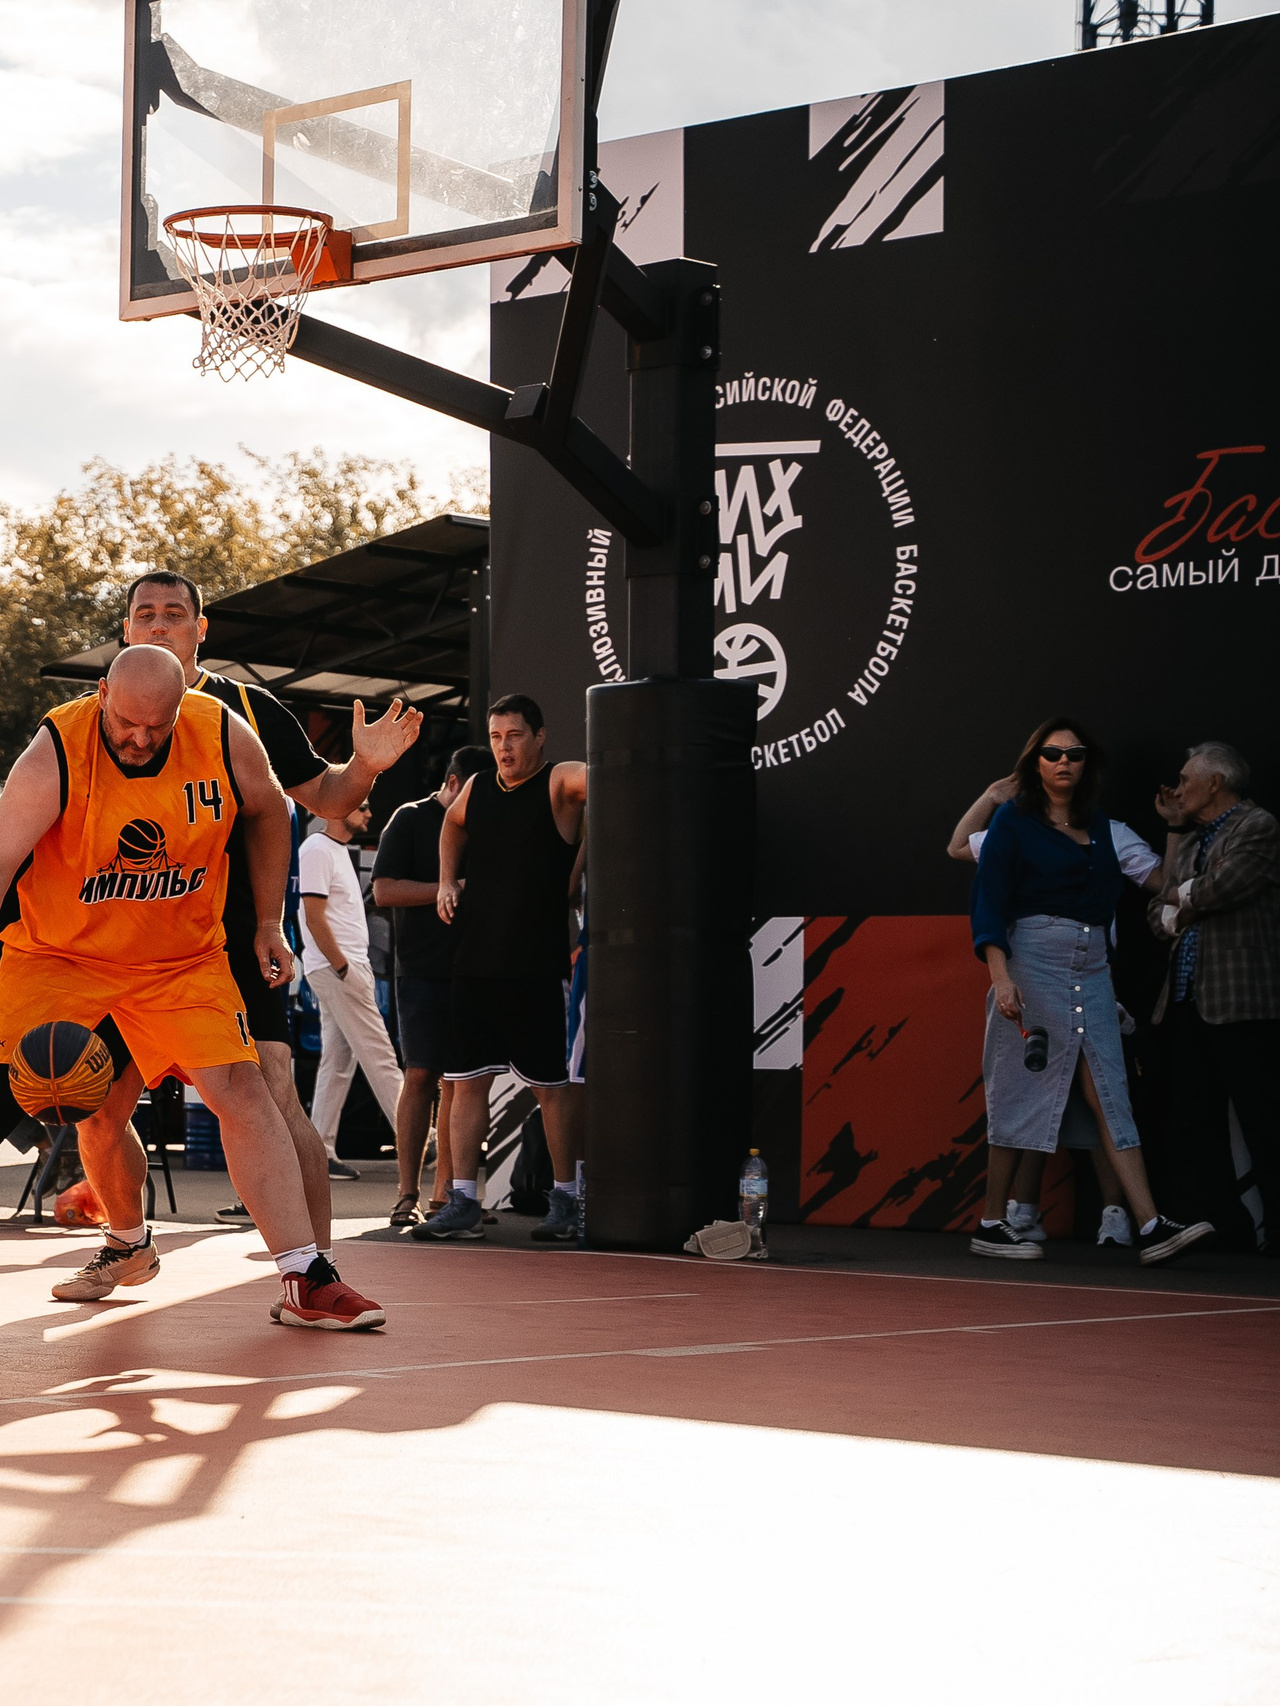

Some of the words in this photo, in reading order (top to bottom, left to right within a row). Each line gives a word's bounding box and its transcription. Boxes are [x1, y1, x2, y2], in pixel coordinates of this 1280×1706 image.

[715, 372, 818, 409] СИЙСКОЙ
[825, 398, 915, 528] ФЕДЕРАЦИИ
[585, 528, 626, 683] КЛЮЗИВНЫЙ
[847, 544, 919, 706] БАСКЕТБОЛА
[751, 708, 846, 770] СКЕТБОЛ
[183, 779, 224, 825] 14
[78, 866, 208, 904] ИМПУЛЬС
